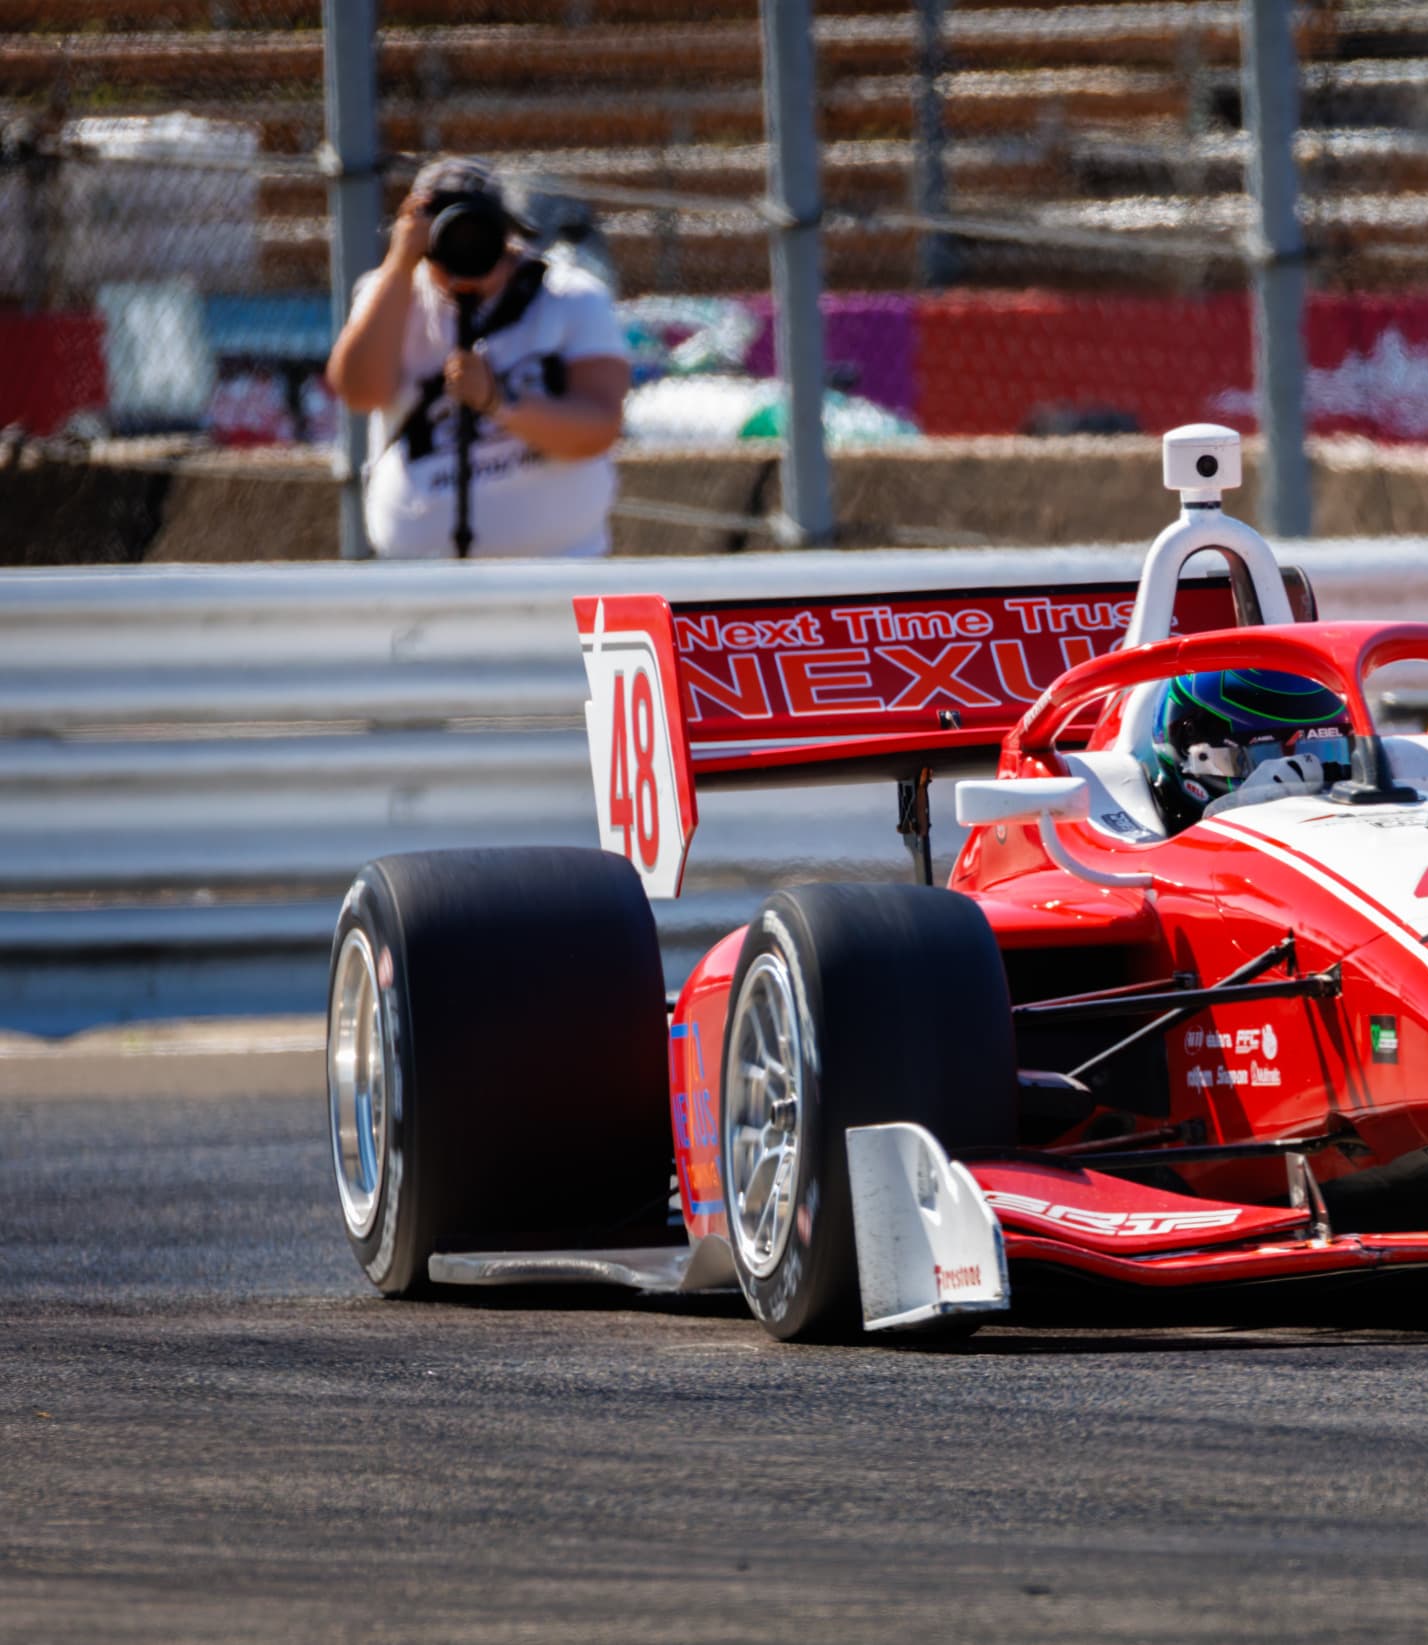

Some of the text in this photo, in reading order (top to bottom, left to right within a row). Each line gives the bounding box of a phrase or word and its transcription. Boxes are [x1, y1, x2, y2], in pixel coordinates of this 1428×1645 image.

[678, 598, 1178, 653] Next Time Trus
[681, 634, 1136, 721] NEXU
[1307, 727, 1343, 739] ABEL
[610, 667, 661, 874] 48
